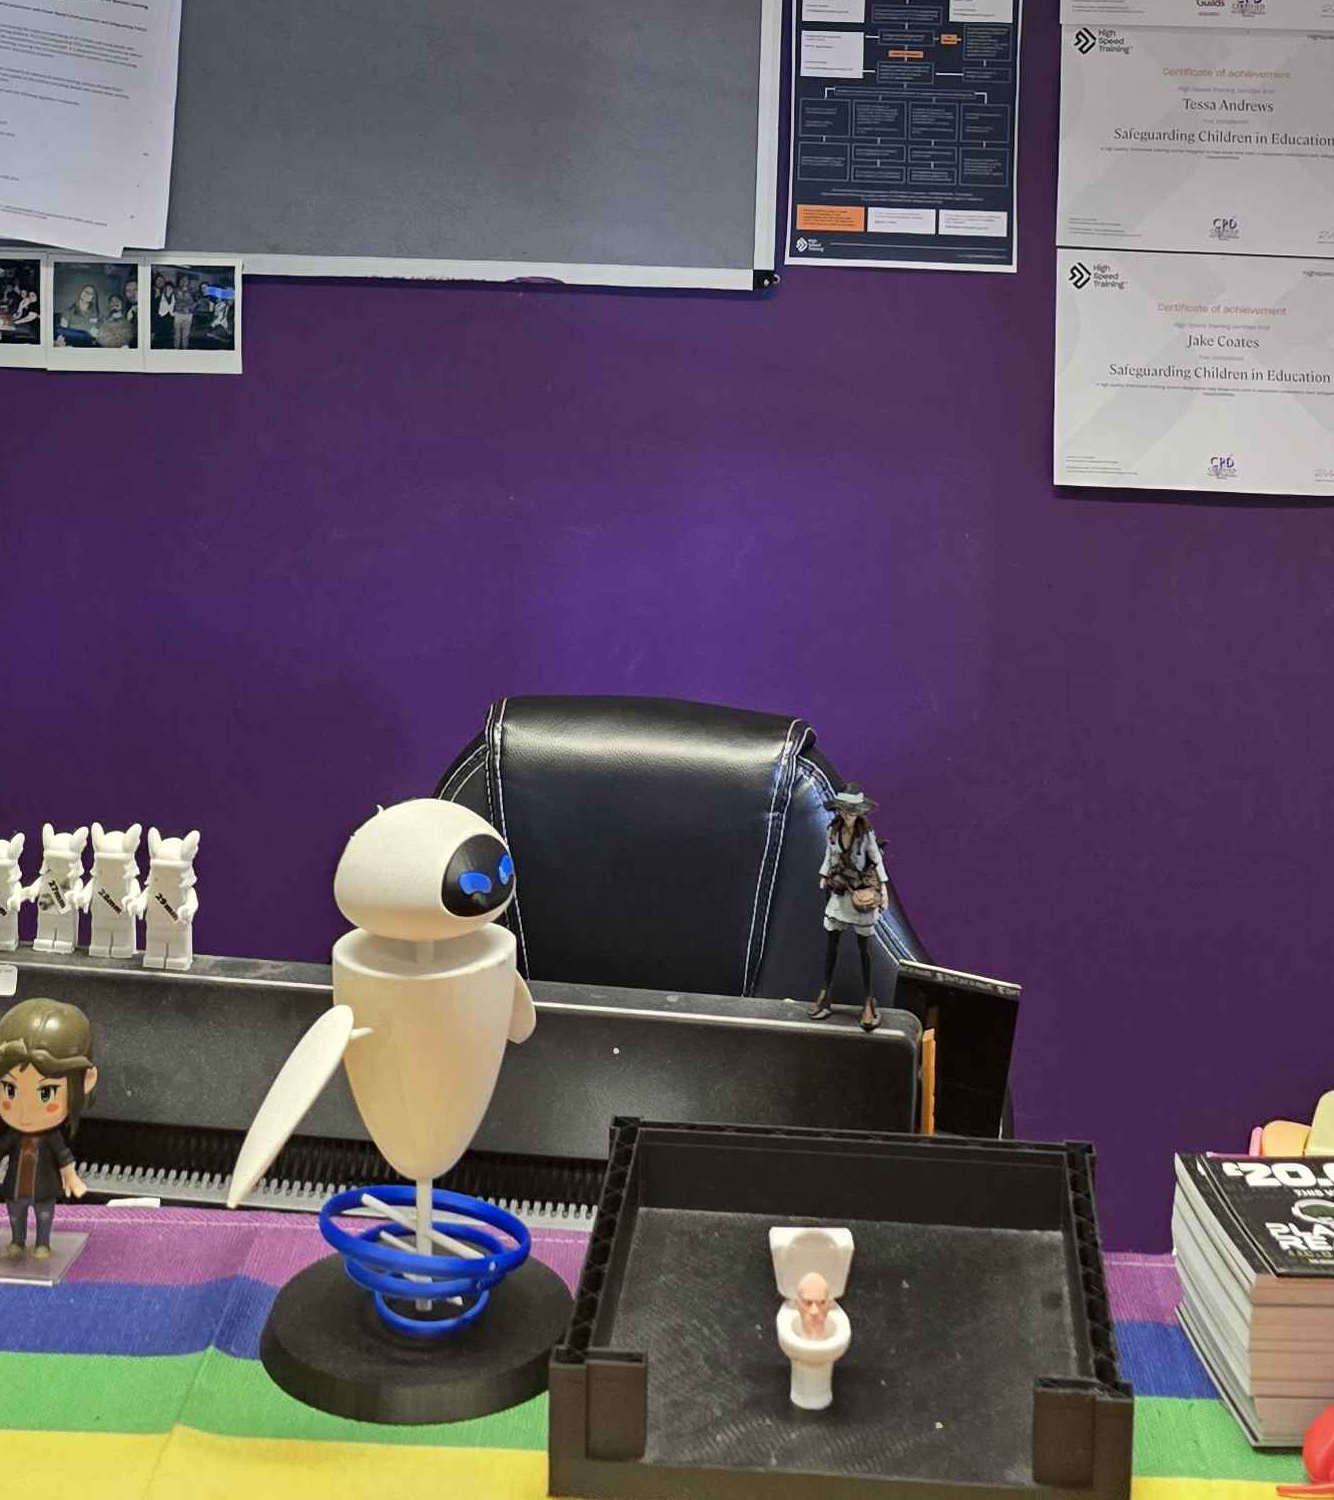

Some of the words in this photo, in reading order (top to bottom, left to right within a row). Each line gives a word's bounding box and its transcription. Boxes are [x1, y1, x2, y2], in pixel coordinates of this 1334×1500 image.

[1182, 98, 1217, 111] Tessa
[1219, 99, 1274, 113] Andrews
[1114, 127, 1196, 143] Safeguarding
[1198, 130, 1252, 145] Children
[1255, 133, 1268, 145] in
[1271, 133, 1334, 147] Education
[1186, 334, 1214, 348] Jake
[1217, 336, 1260, 349] Coates
[1109, 363, 1191, 380] Safeguarding
[1194, 366, 1248, 382] Children
[1251, 369, 1264, 382] in
[1267, 369, 1331, 384] Education
